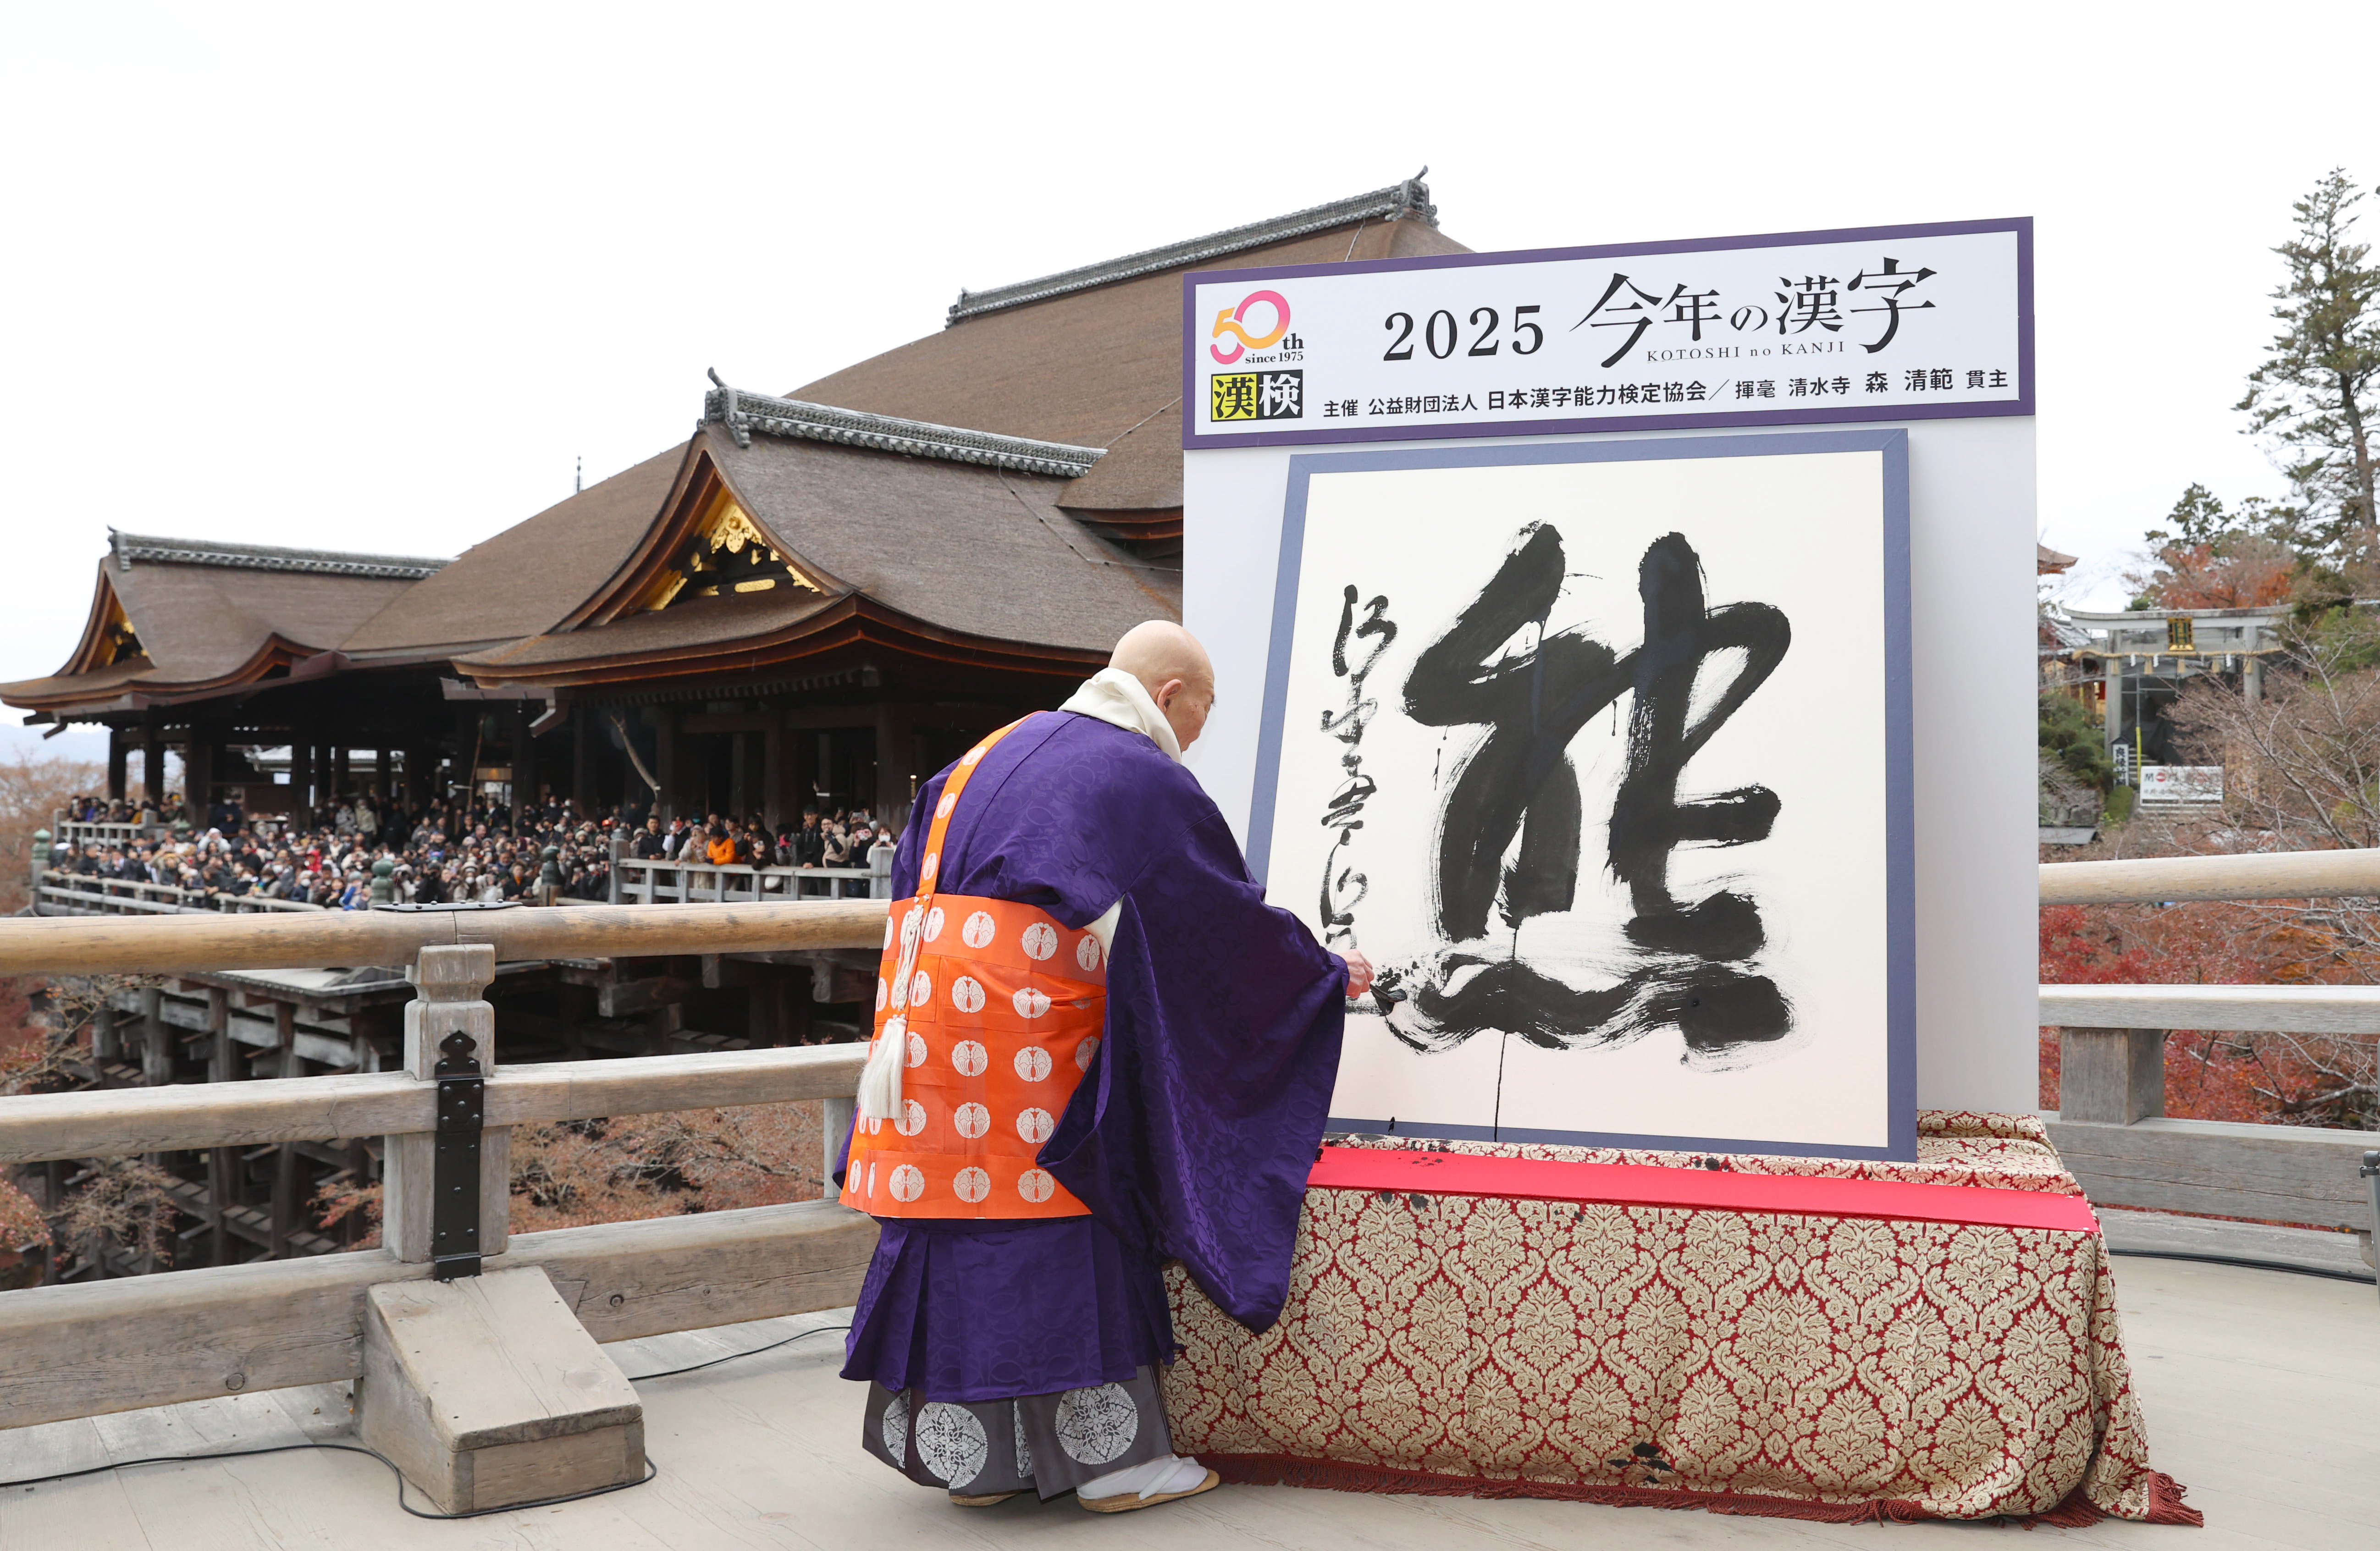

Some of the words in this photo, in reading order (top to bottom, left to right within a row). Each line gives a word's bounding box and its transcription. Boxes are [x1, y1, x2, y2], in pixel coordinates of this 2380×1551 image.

[1383, 305, 1543, 361] 2025
[1569, 255, 1937, 368] 今年の漢字
[1245, 353, 1276, 364] since
[1279, 351, 1303, 362] 1975
[1647, 346, 1739, 361] KOTOSHI
[1782, 341, 1843, 355] KANJI
[1214, 374, 1301, 418] 漢検
[1323, 399, 1358, 417] 主催
[1369, 394, 1478, 415] 公益財団法人
[1789, 376, 1850, 397] 清水寺
[1865, 371, 1888, 393] 森
[1904, 368, 1953, 392] 清範
[1966, 369, 2008, 389] 貫主
[1385, 519, 1804, 1073] 熊
